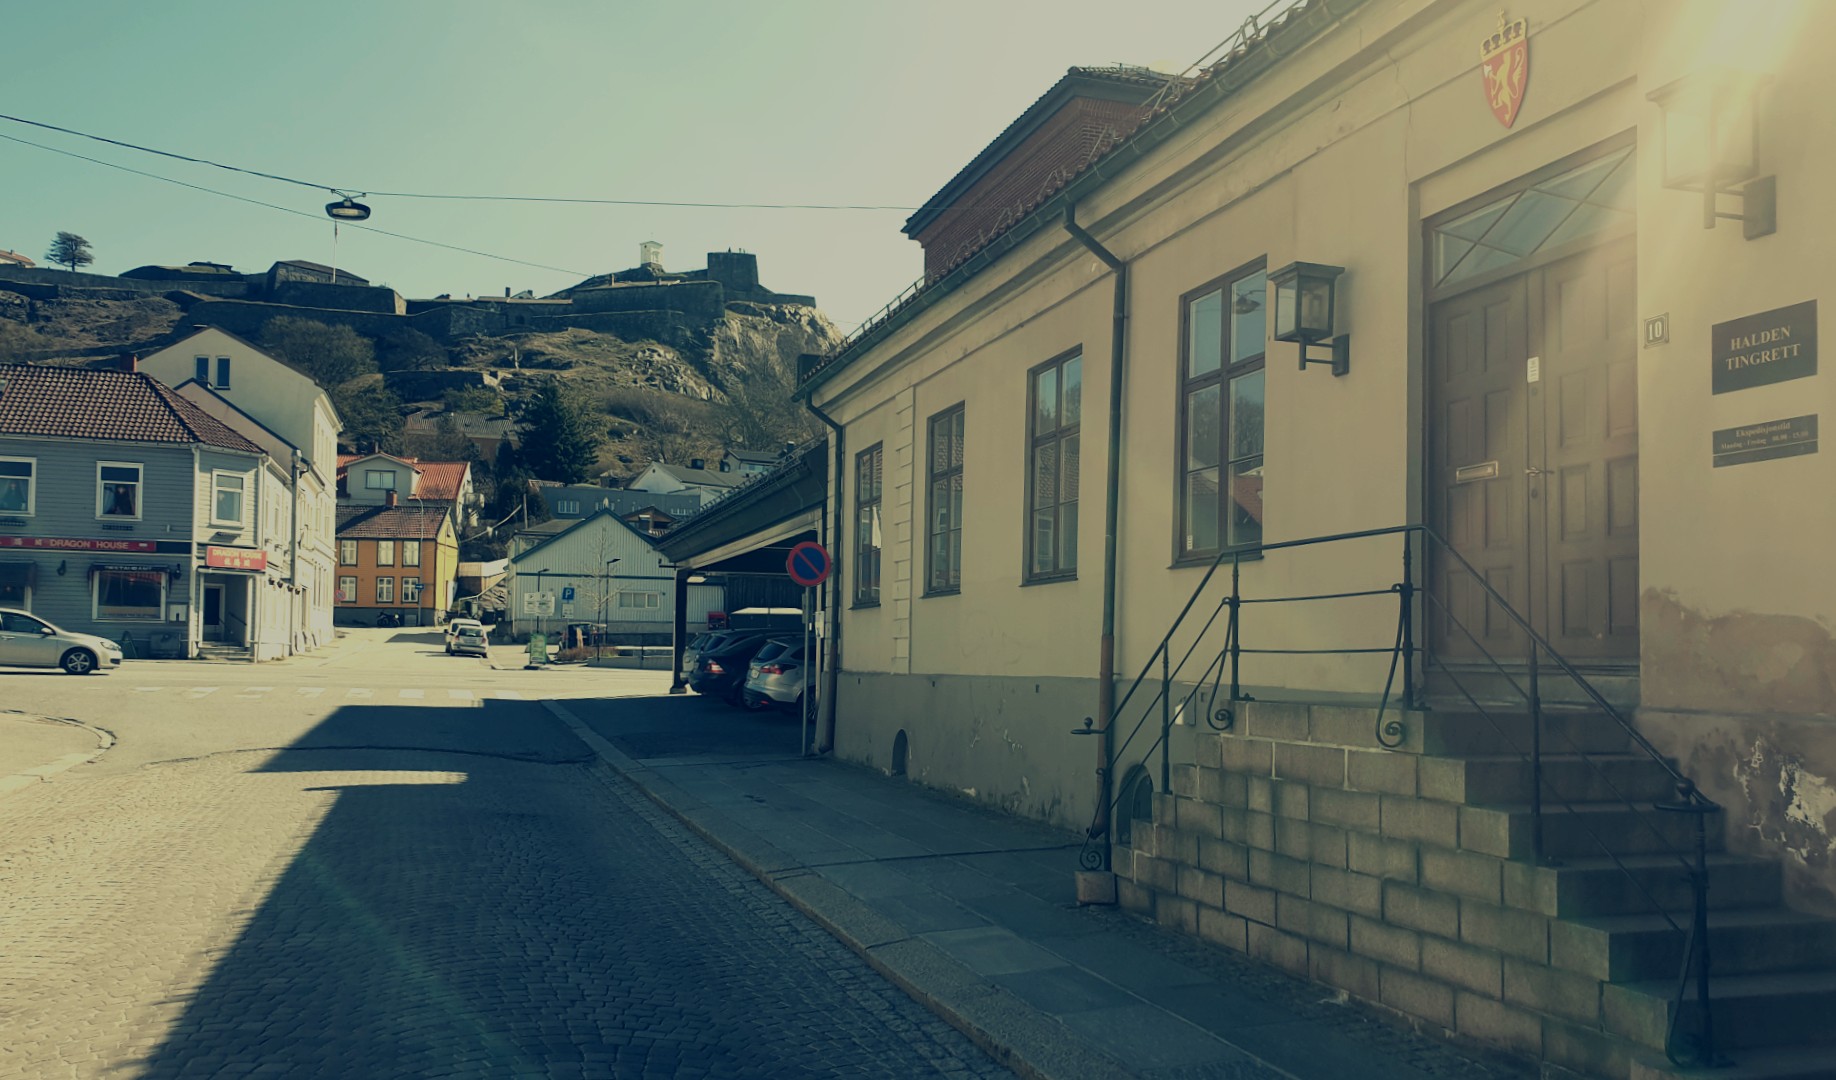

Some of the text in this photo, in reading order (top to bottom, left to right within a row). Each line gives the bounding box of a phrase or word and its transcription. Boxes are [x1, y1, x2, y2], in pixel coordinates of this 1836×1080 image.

[1649, 321, 1662, 340] 10
[1731, 325, 1791, 351] HALDEN
[1726, 343, 1801, 370] TINGRETT
[49, 538, 91, 548] DRAGON
[96, 540, 129, 550] HOUSE
